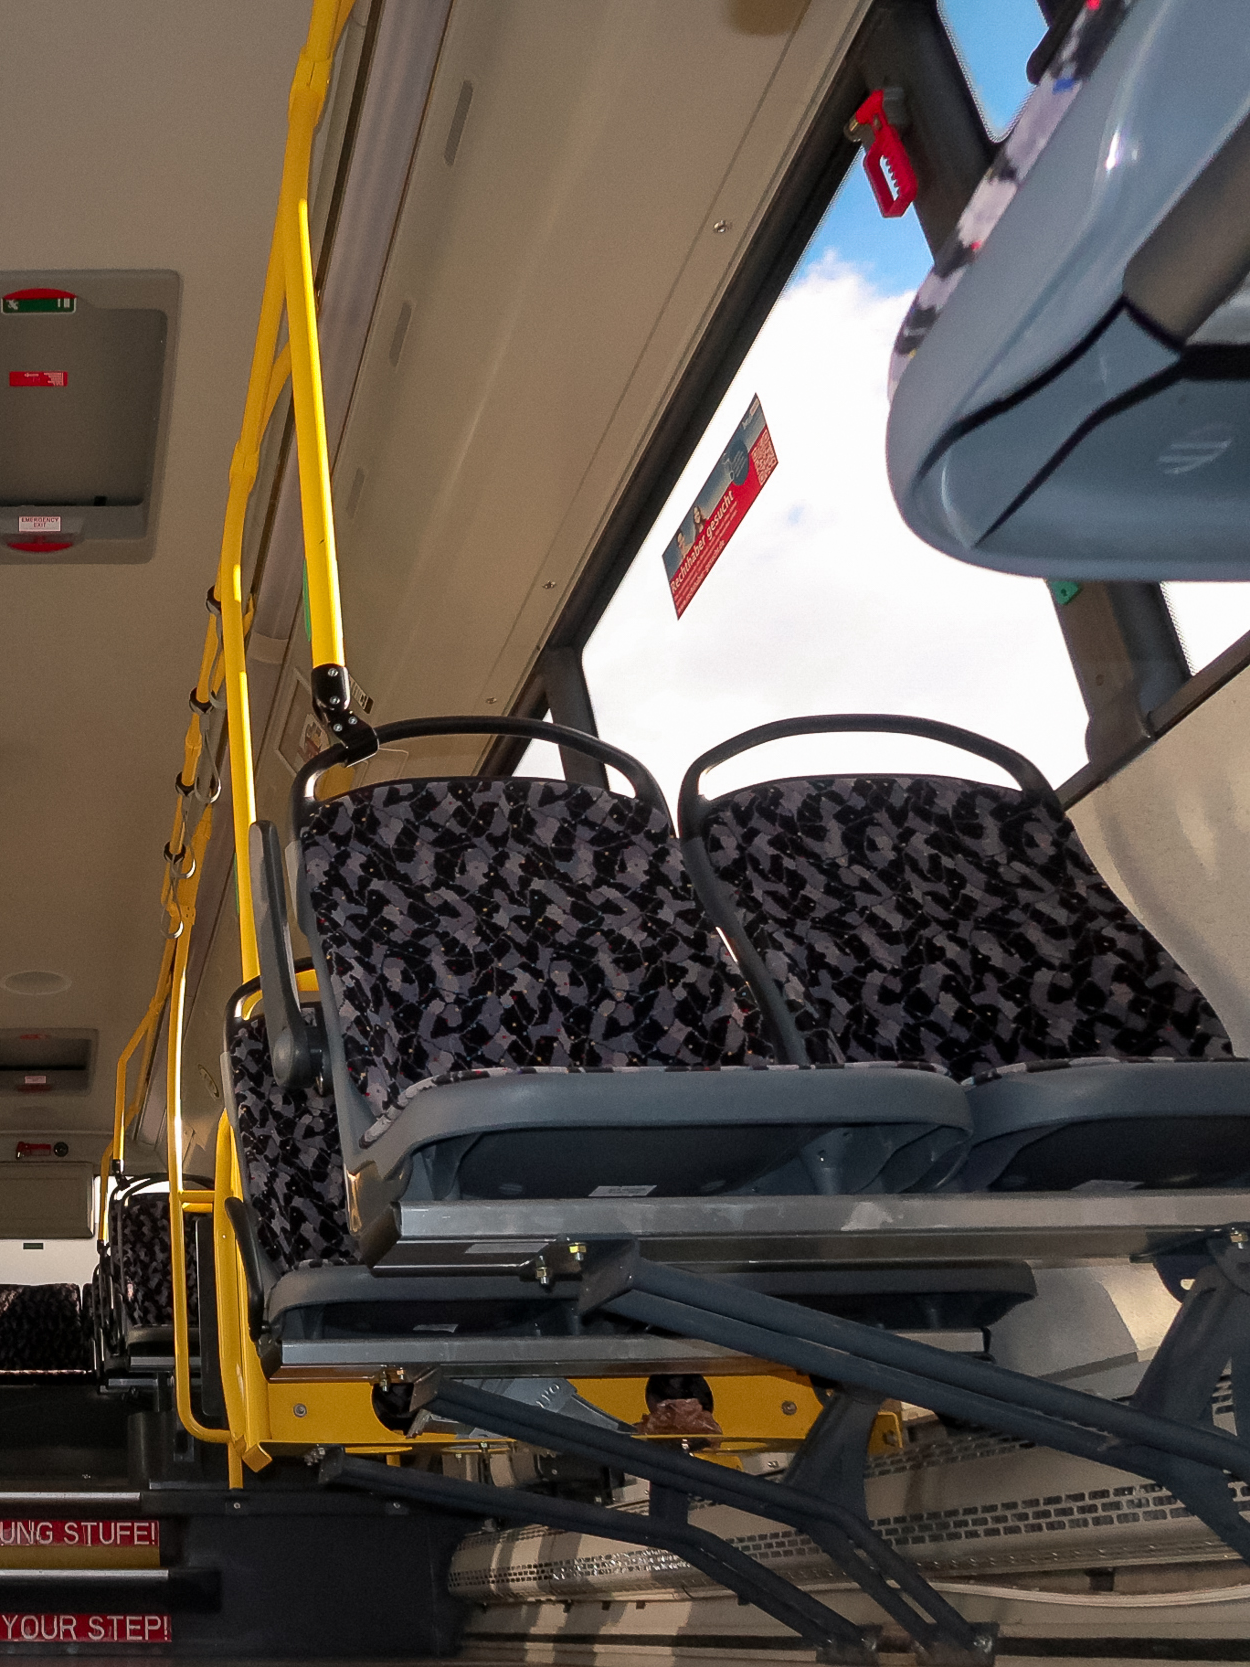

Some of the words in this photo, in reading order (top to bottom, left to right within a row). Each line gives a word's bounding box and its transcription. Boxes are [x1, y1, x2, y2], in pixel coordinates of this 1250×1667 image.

[670, 534, 706, 594] Rechthaber
[706, 490, 734, 541] gesucht
[63, 1521, 157, 1546] STUFE!
[2, 1614, 77, 1640] YOUR
[88, 1615, 170, 1641] STEP!
